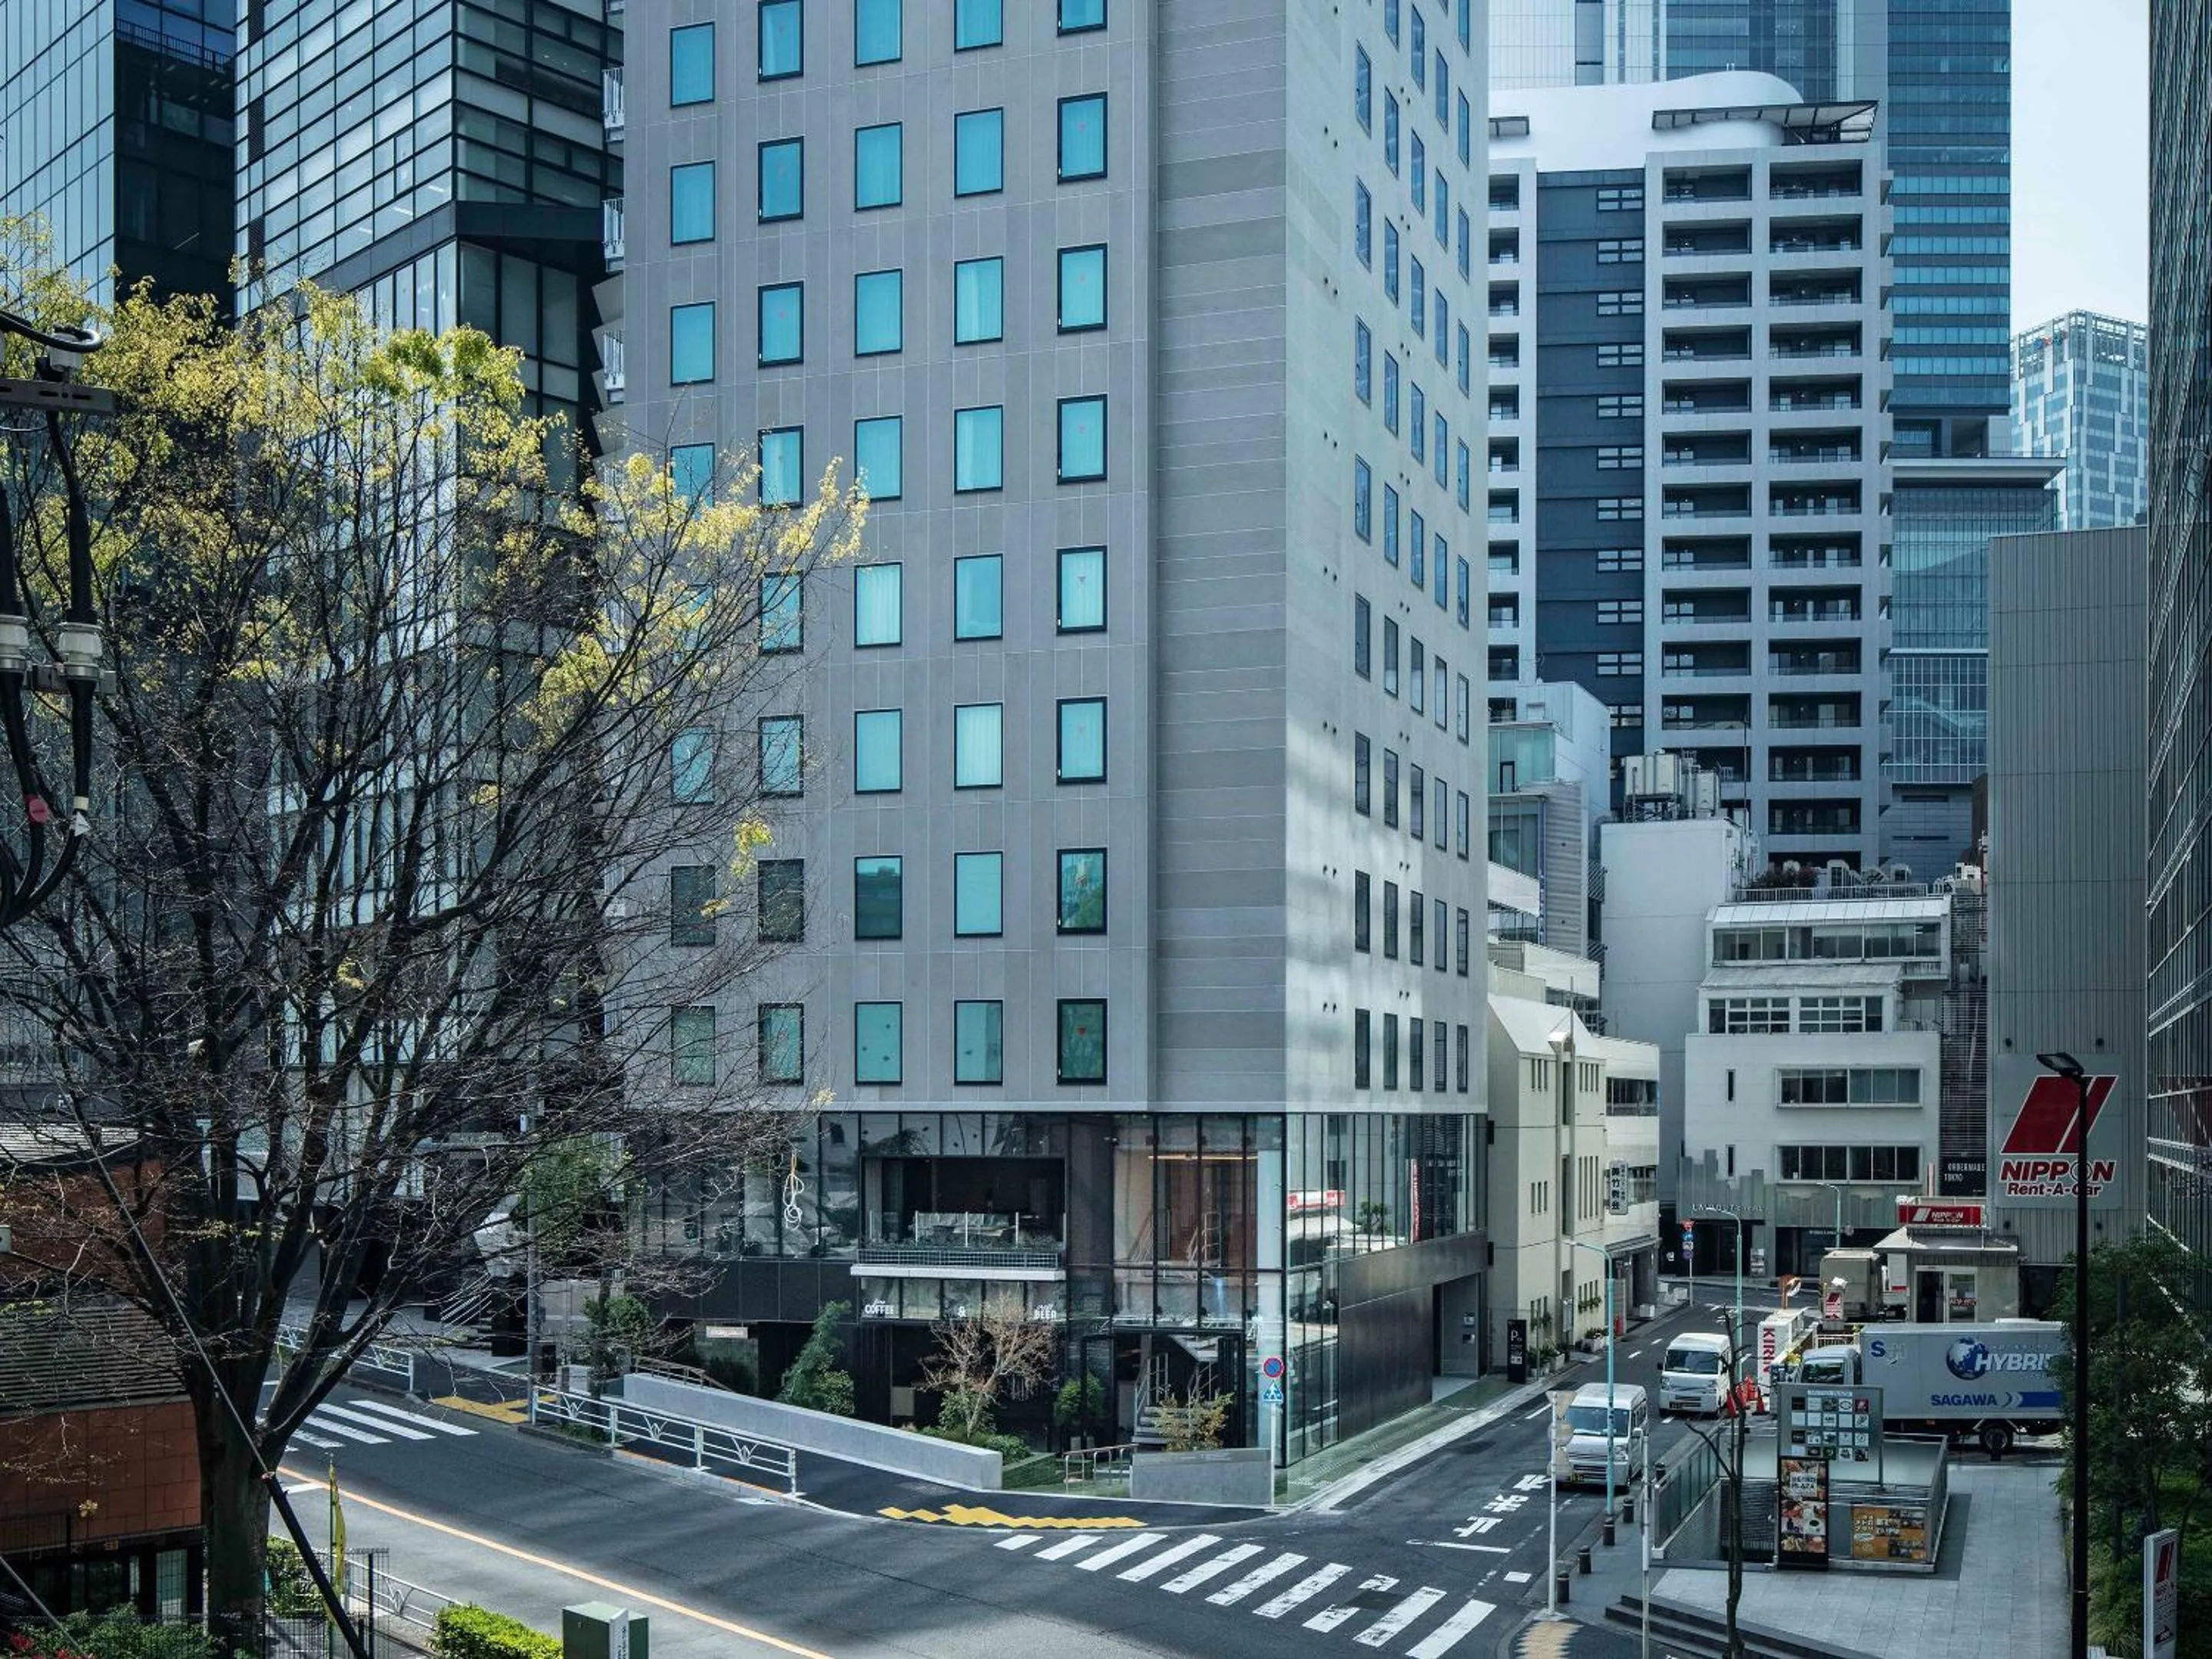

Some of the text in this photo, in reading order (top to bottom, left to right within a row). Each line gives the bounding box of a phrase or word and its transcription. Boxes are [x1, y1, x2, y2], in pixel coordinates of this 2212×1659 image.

[1999, 1160, 2116, 1181] NIPPON
[865, 1304, 894, 1315] COFFEE
[1930, 1393, 1998, 1406] SAGAWA
